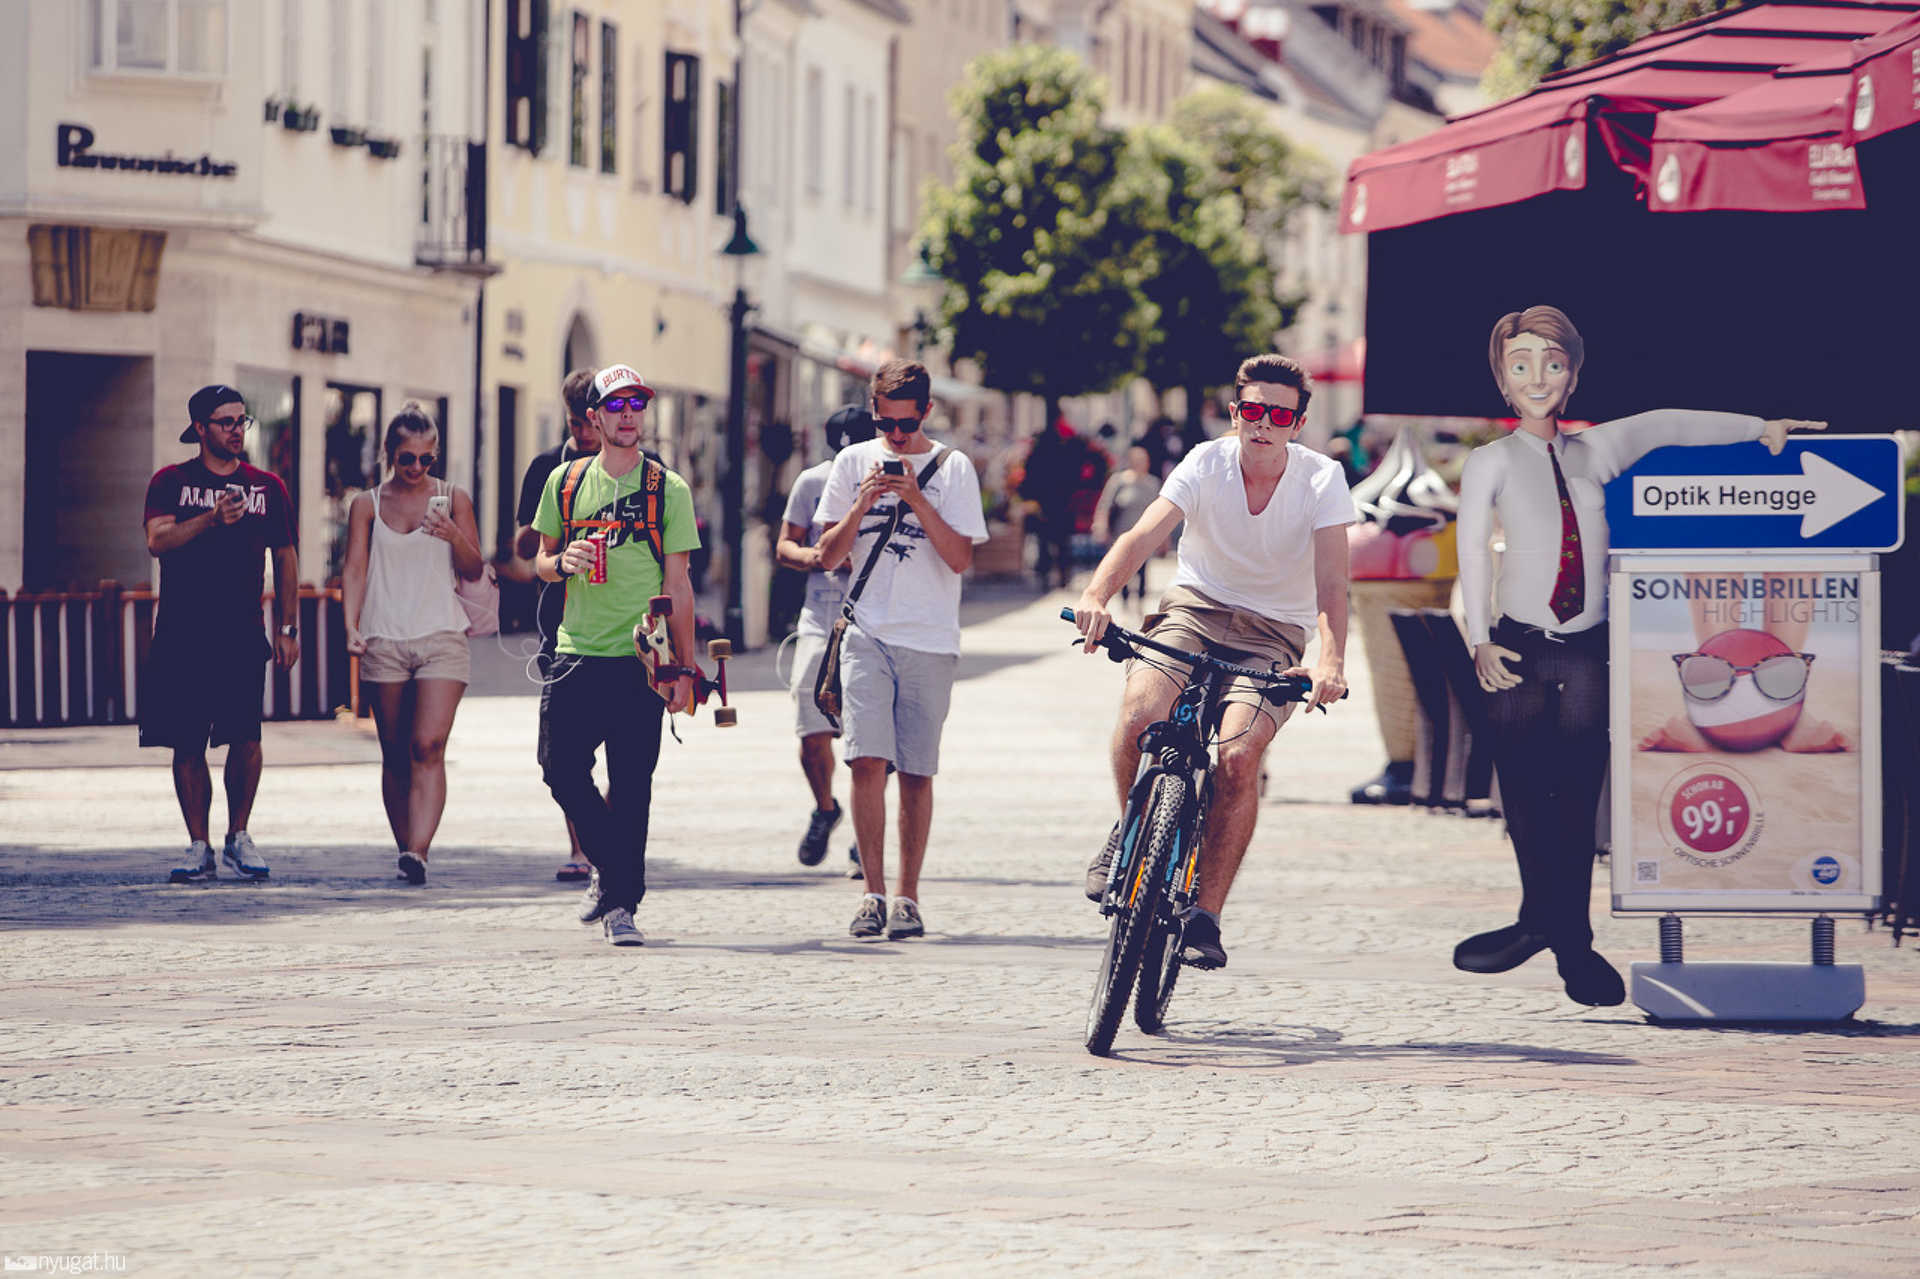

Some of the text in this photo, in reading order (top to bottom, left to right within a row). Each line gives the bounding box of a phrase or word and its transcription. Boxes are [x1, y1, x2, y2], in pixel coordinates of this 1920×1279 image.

[1643, 485, 1816, 511] Optik Hengge
[1632, 576, 1859, 601] SONNENBRILLEN
[1702, 600, 1859, 624] HIGHLIGHTS
